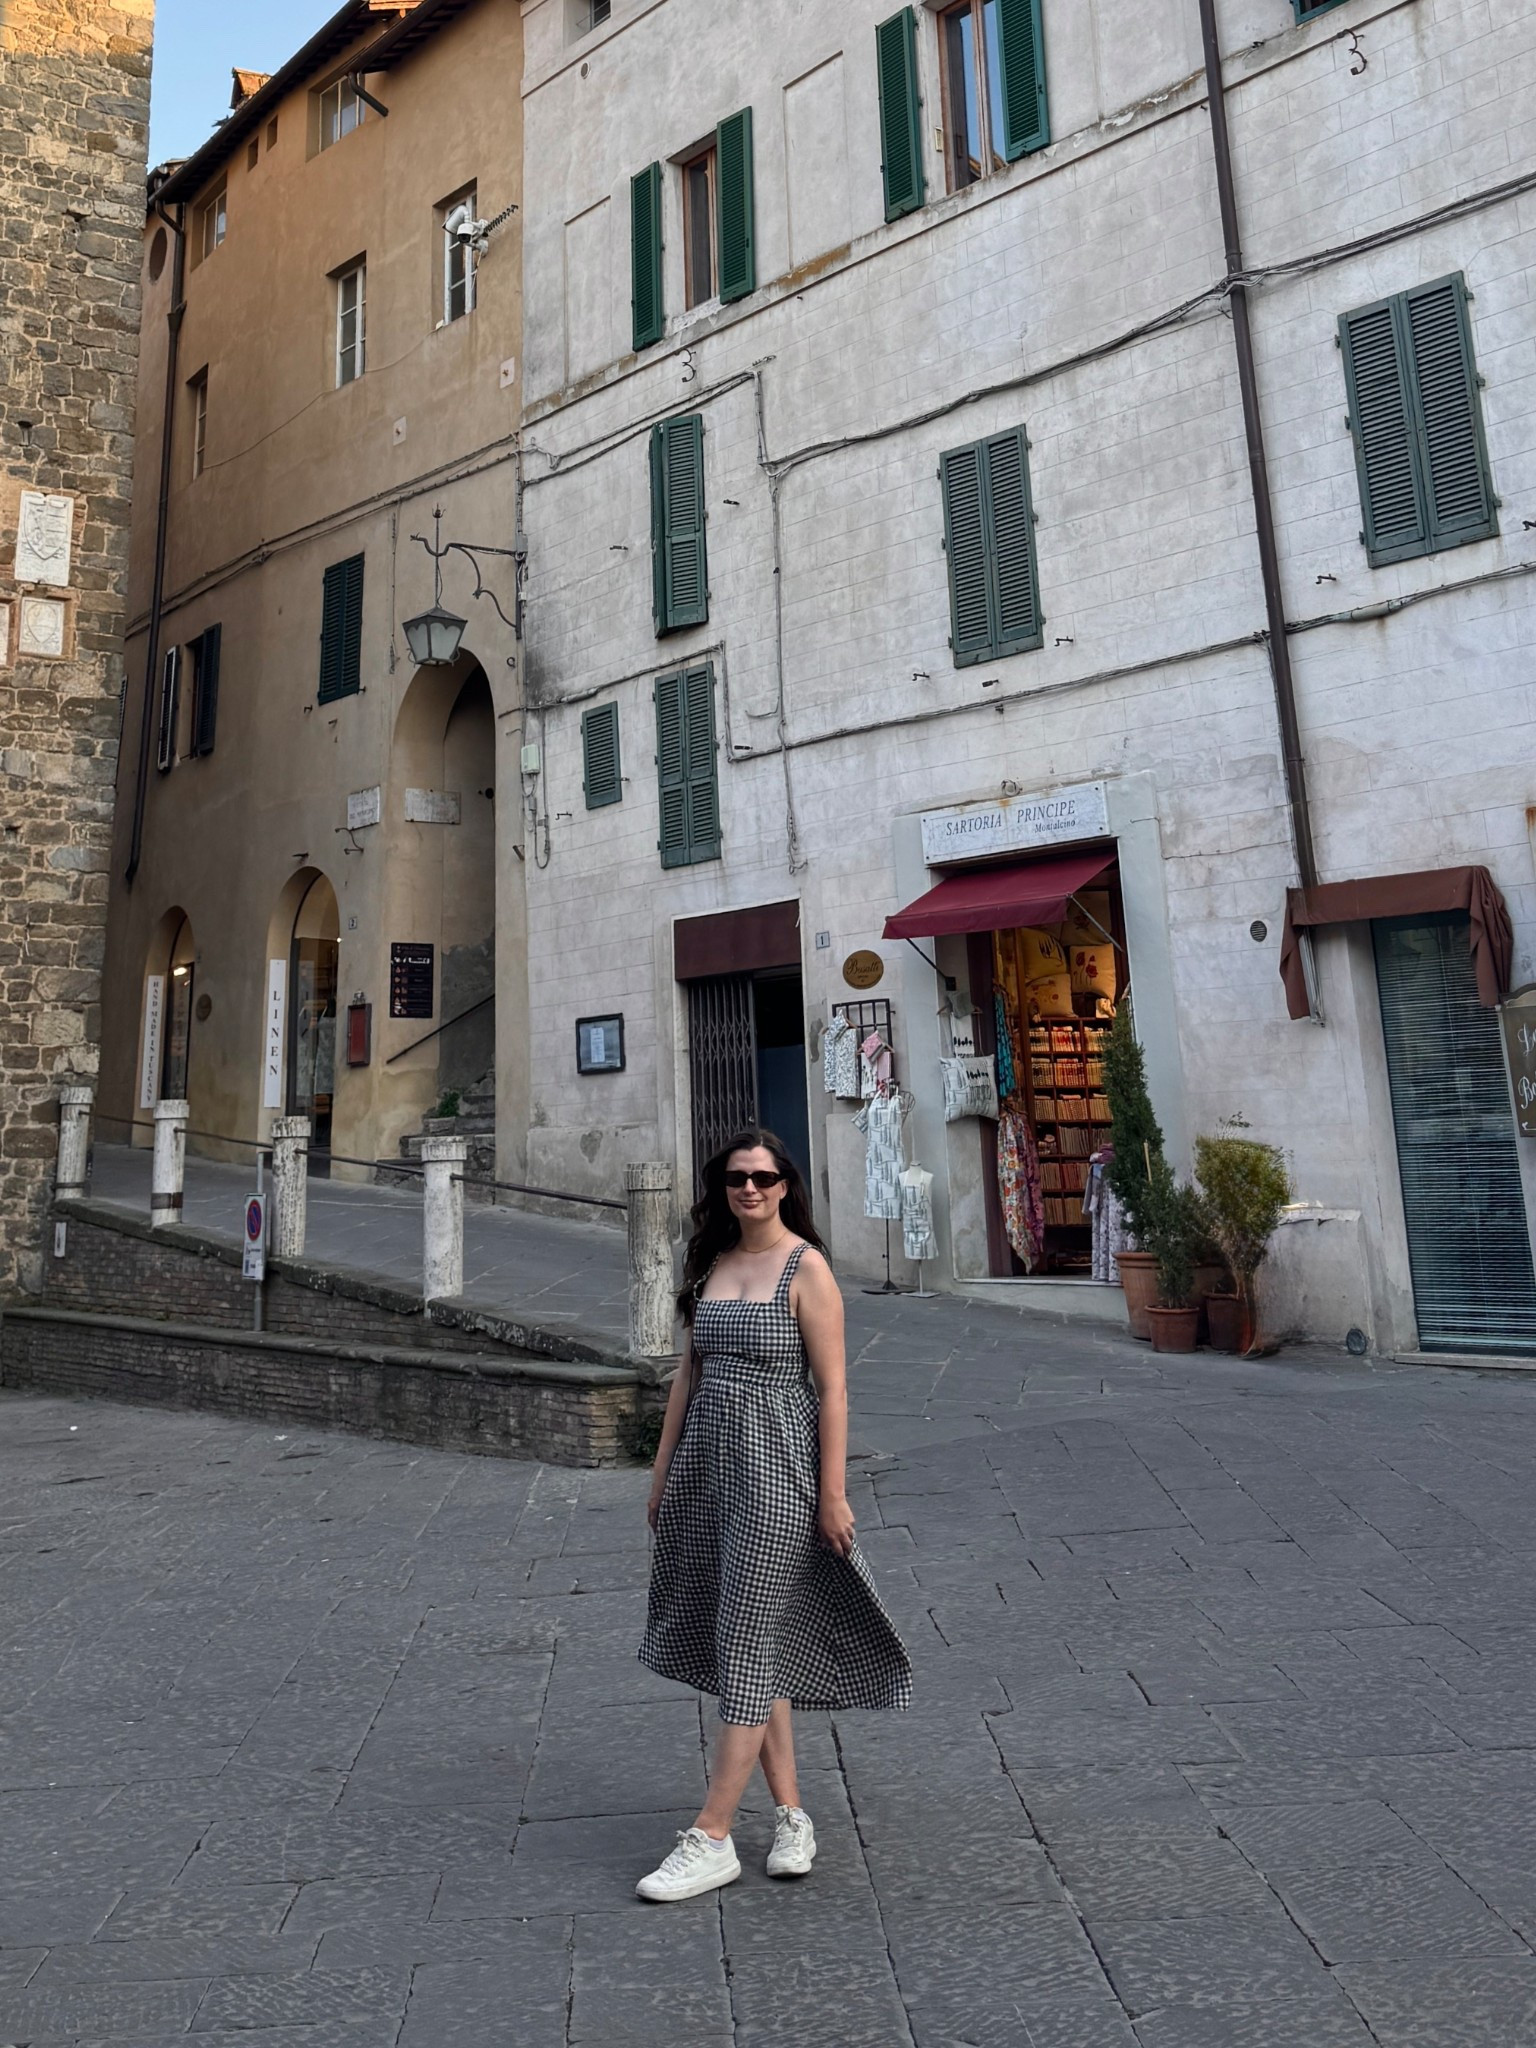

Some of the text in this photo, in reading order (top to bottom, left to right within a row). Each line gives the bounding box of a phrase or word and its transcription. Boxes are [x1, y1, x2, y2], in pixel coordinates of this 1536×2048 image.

[946, 799, 1076, 836] SARTORIA PRINCIPE
[269, 990, 281, 1076] LINEN
